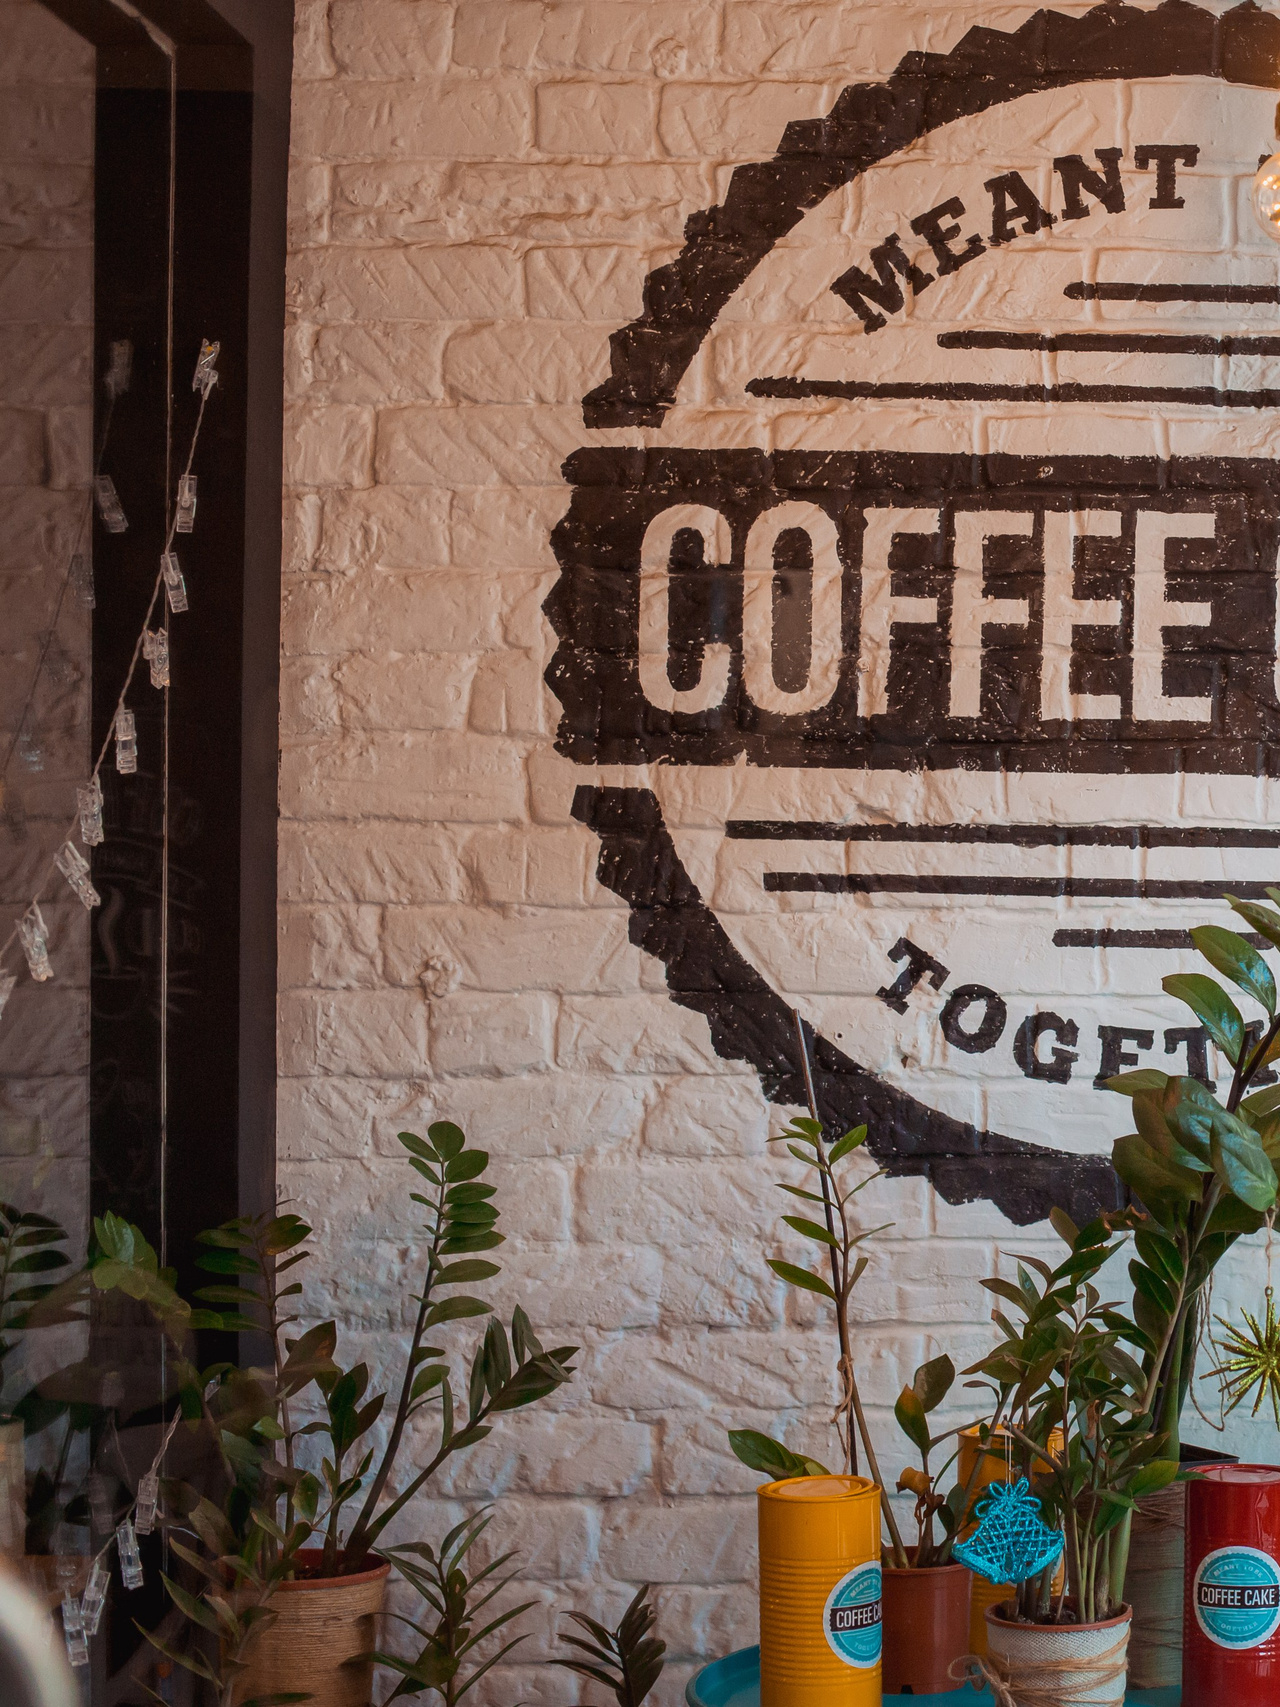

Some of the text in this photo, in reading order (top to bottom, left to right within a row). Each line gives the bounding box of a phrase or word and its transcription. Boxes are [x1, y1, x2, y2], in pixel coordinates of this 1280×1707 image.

[829, 144, 1199, 333] MEANT
[638, 500, 1216, 723] COFFEE
[836, 1605, 872, 1628] COFFEE
[1201, 1586, 1276, 1606] COFFEE CAKE
